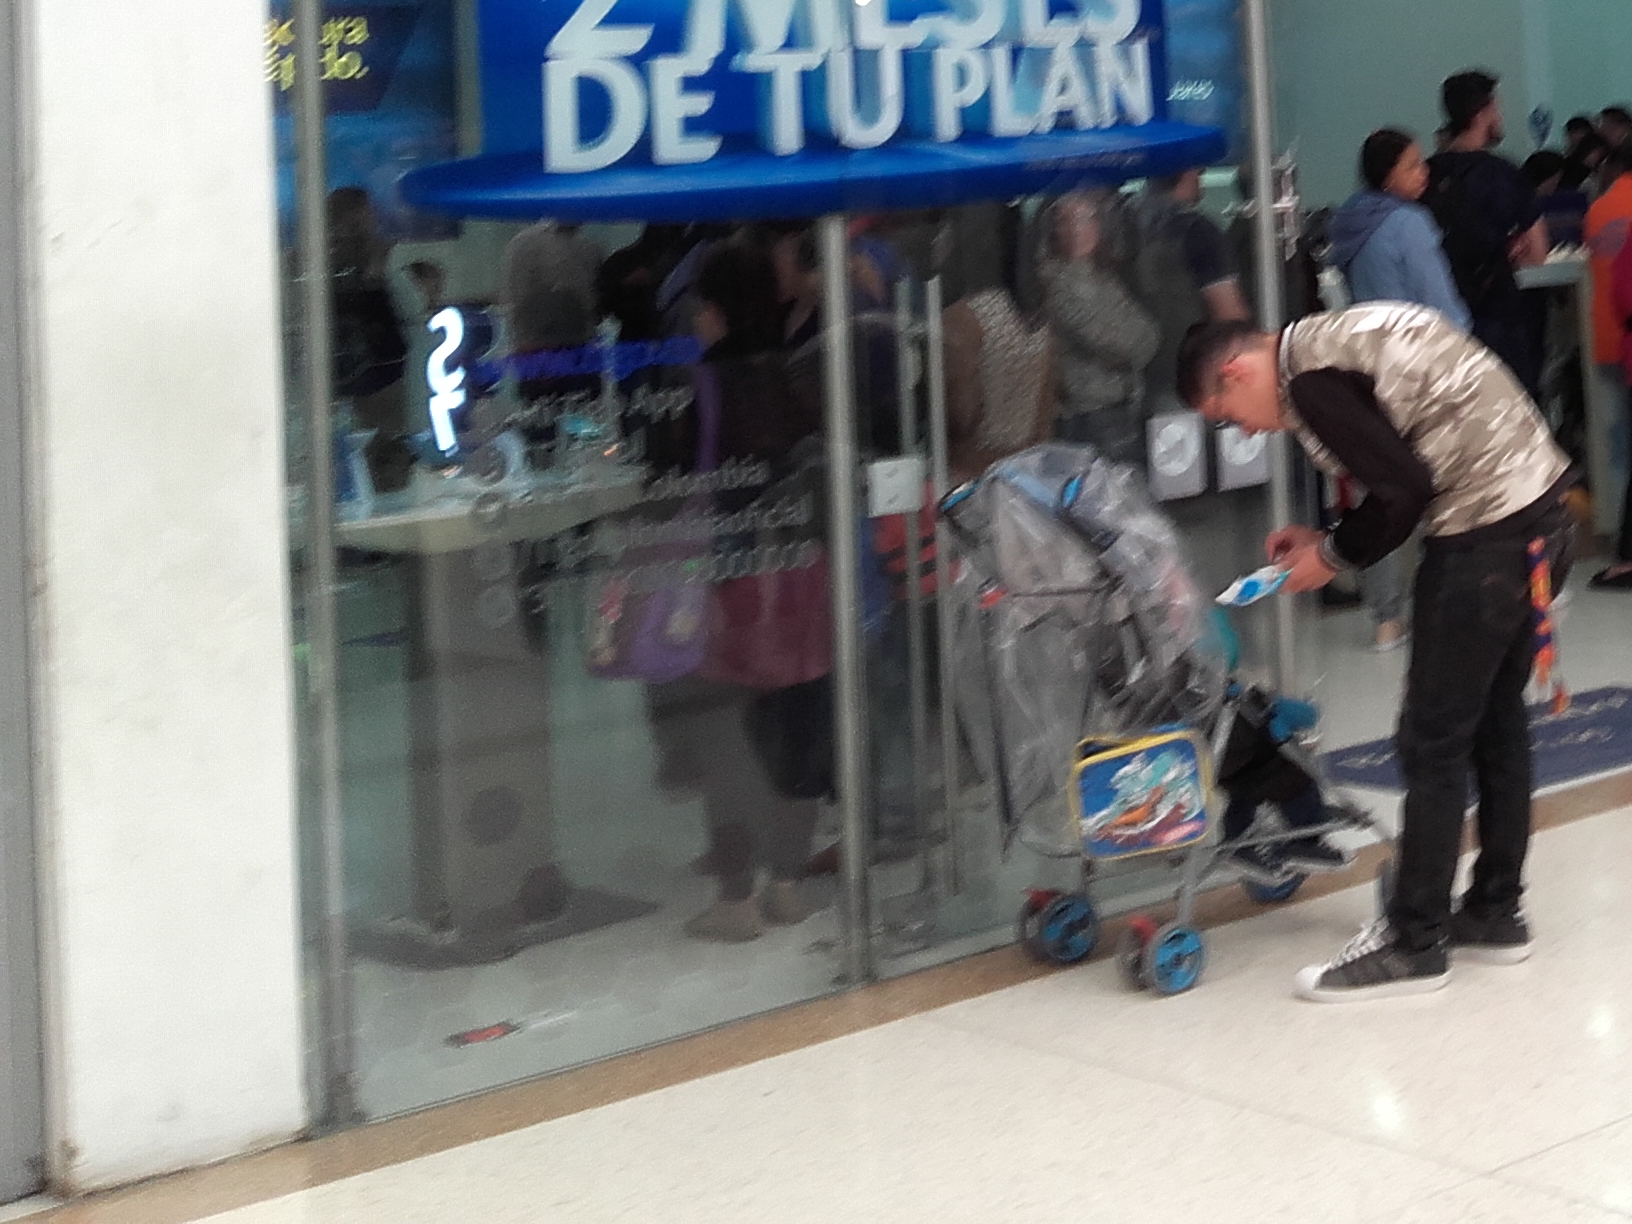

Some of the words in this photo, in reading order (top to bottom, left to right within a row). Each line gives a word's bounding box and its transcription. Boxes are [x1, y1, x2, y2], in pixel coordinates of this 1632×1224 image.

[542, 53, 724, 174] DE
[731, 44, 904, 156] TU
[932, 36, 1155, 143] PLAN
